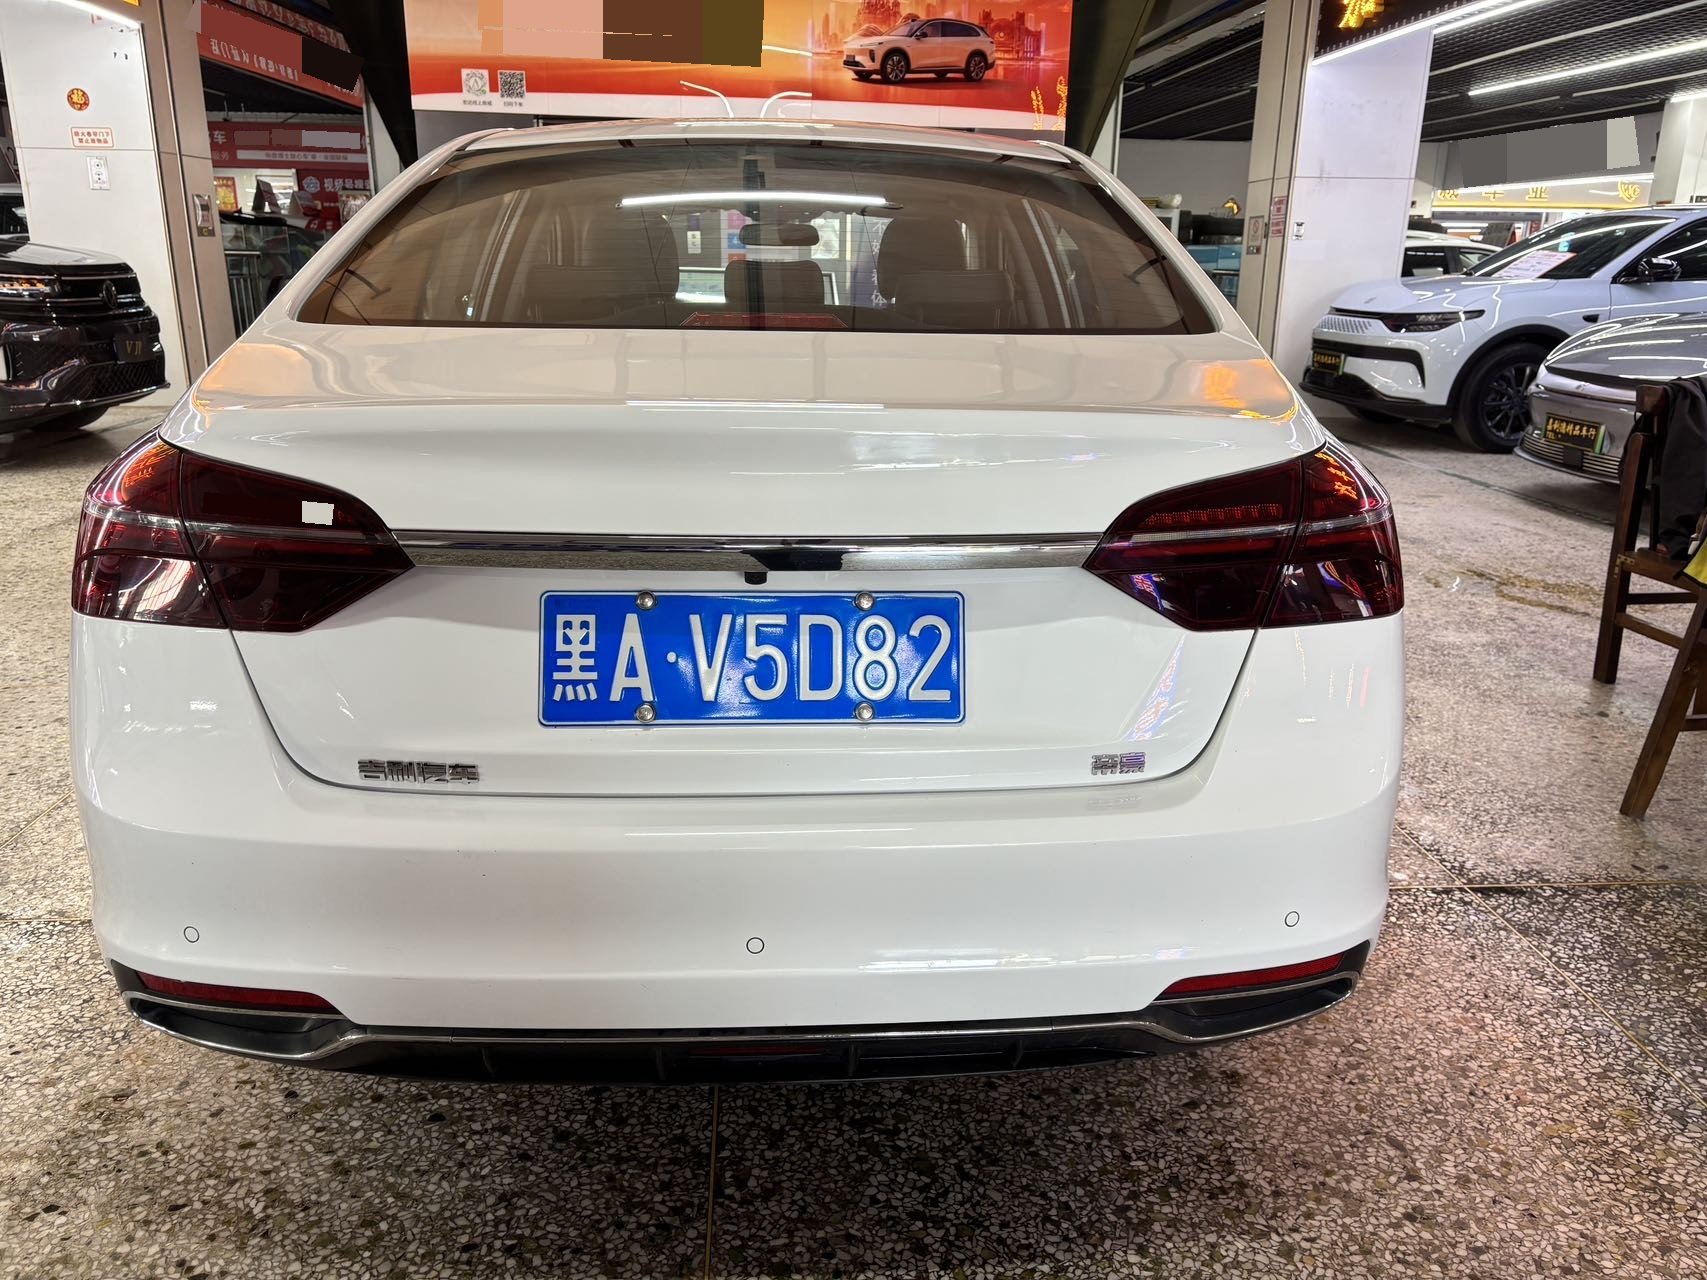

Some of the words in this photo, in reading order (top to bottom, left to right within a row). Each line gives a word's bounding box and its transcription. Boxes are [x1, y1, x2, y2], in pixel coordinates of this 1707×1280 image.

[358, 760, 480, 784] 吉利汽车
[1091, 752, 1146, 776] 帝豪
